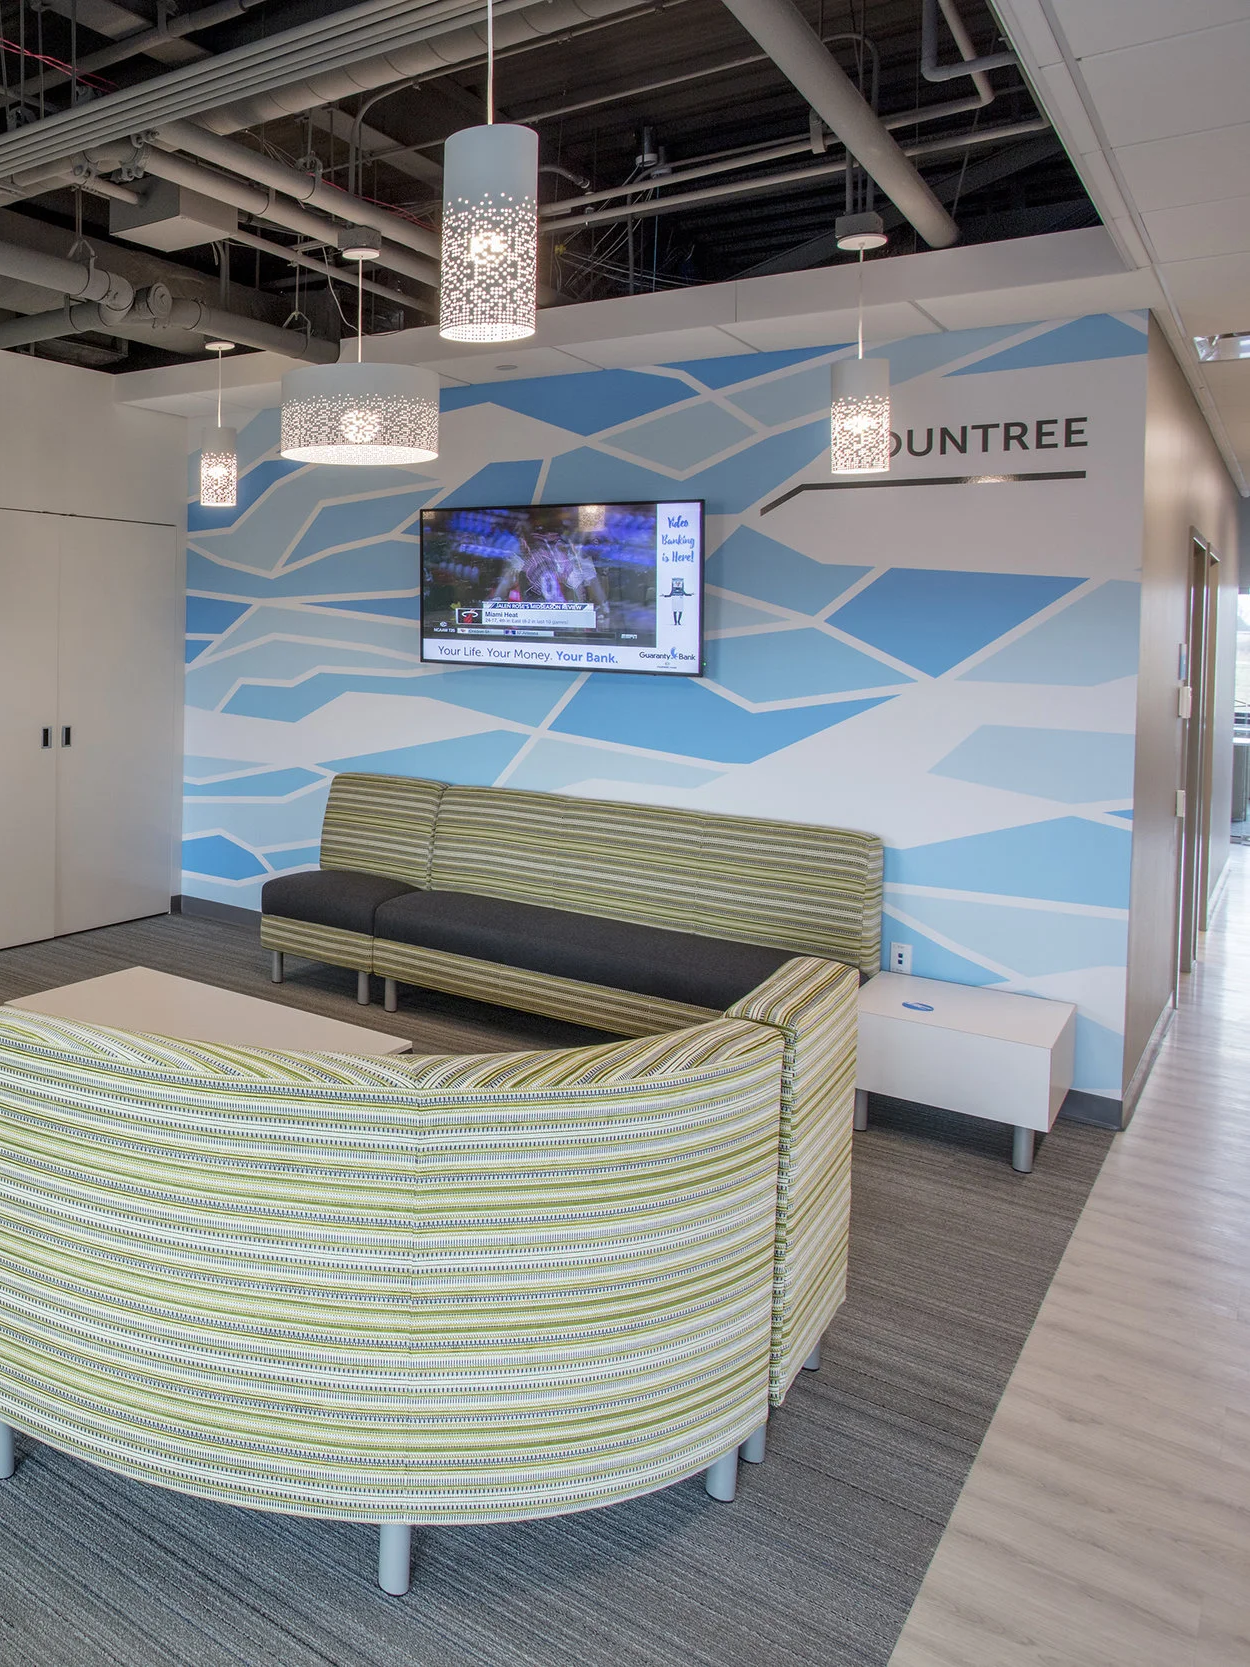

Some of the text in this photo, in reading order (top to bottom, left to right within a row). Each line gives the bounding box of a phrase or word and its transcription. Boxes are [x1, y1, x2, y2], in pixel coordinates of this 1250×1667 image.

[668, 515, 689, 528] Video
[661, 533, 695, 549] Banking
[662, 550, 694, 562] is Here!
[438, 645, 619, 664] Your Life. Your Money. Your Bank.
[639, 651, 696, 661] Guaranty Bank
